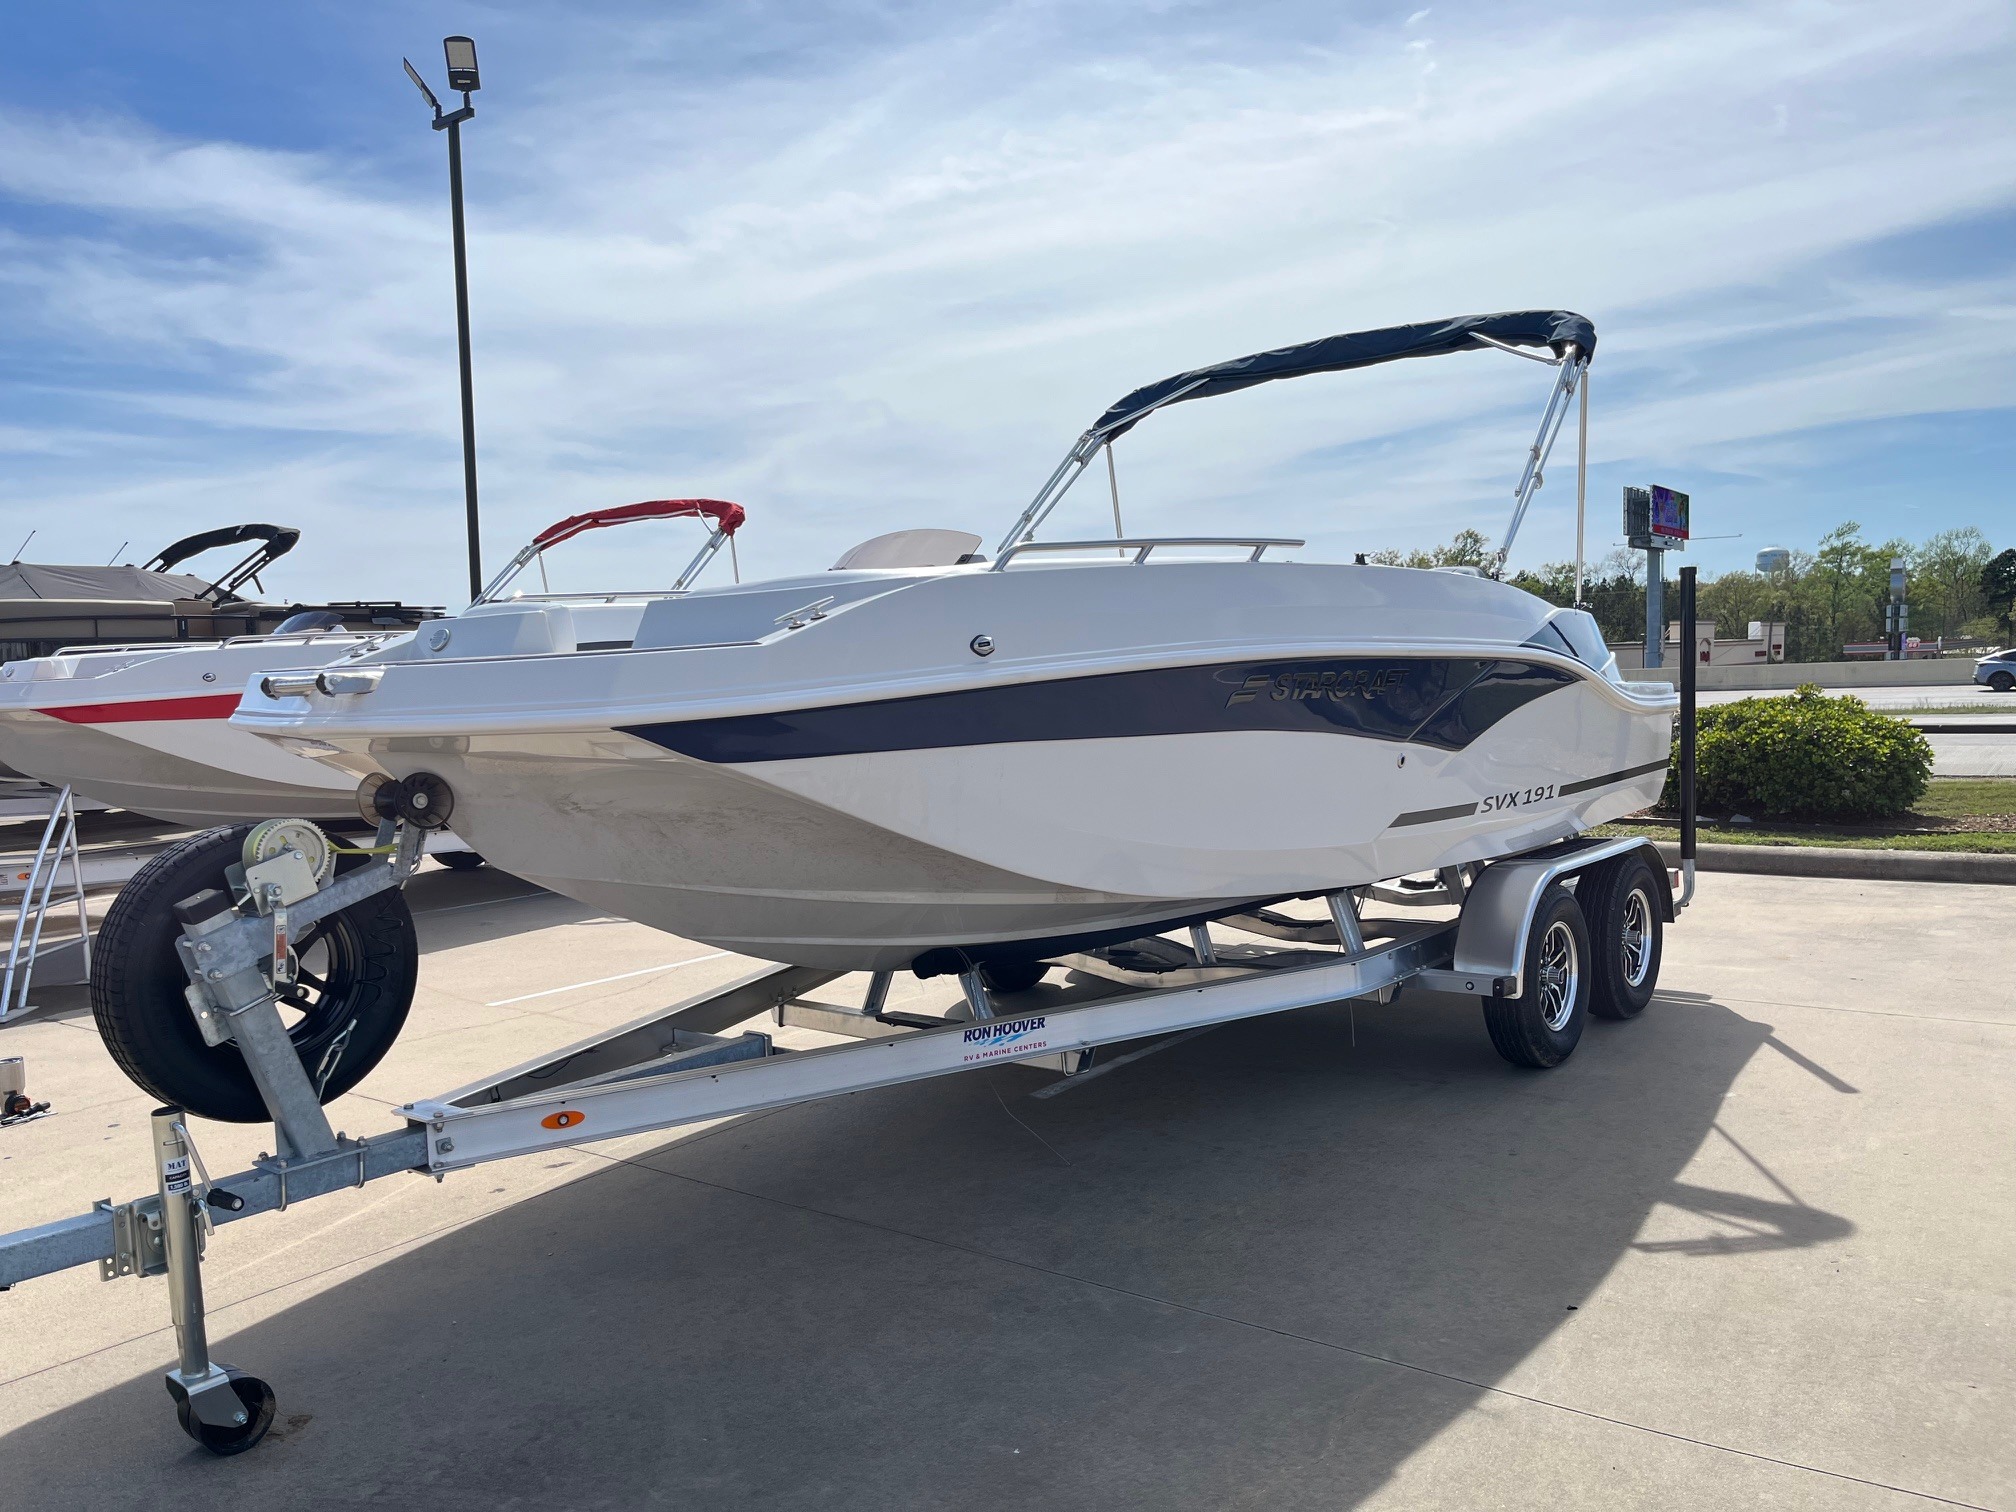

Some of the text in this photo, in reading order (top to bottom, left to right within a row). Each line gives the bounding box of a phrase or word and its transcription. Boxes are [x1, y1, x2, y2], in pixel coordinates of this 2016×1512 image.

[1271, 668, 1410, 702] STARCRAFT
[1480, 784, 1554, 813] SVX 191
[964, 1016, 1046, 1043] RON HOOVER
[964, 1054, 974, 1062] RV
[982, 1047, 1012, 1058] MARINE
[1014, 1040, 1047, 1052] CENTERS
